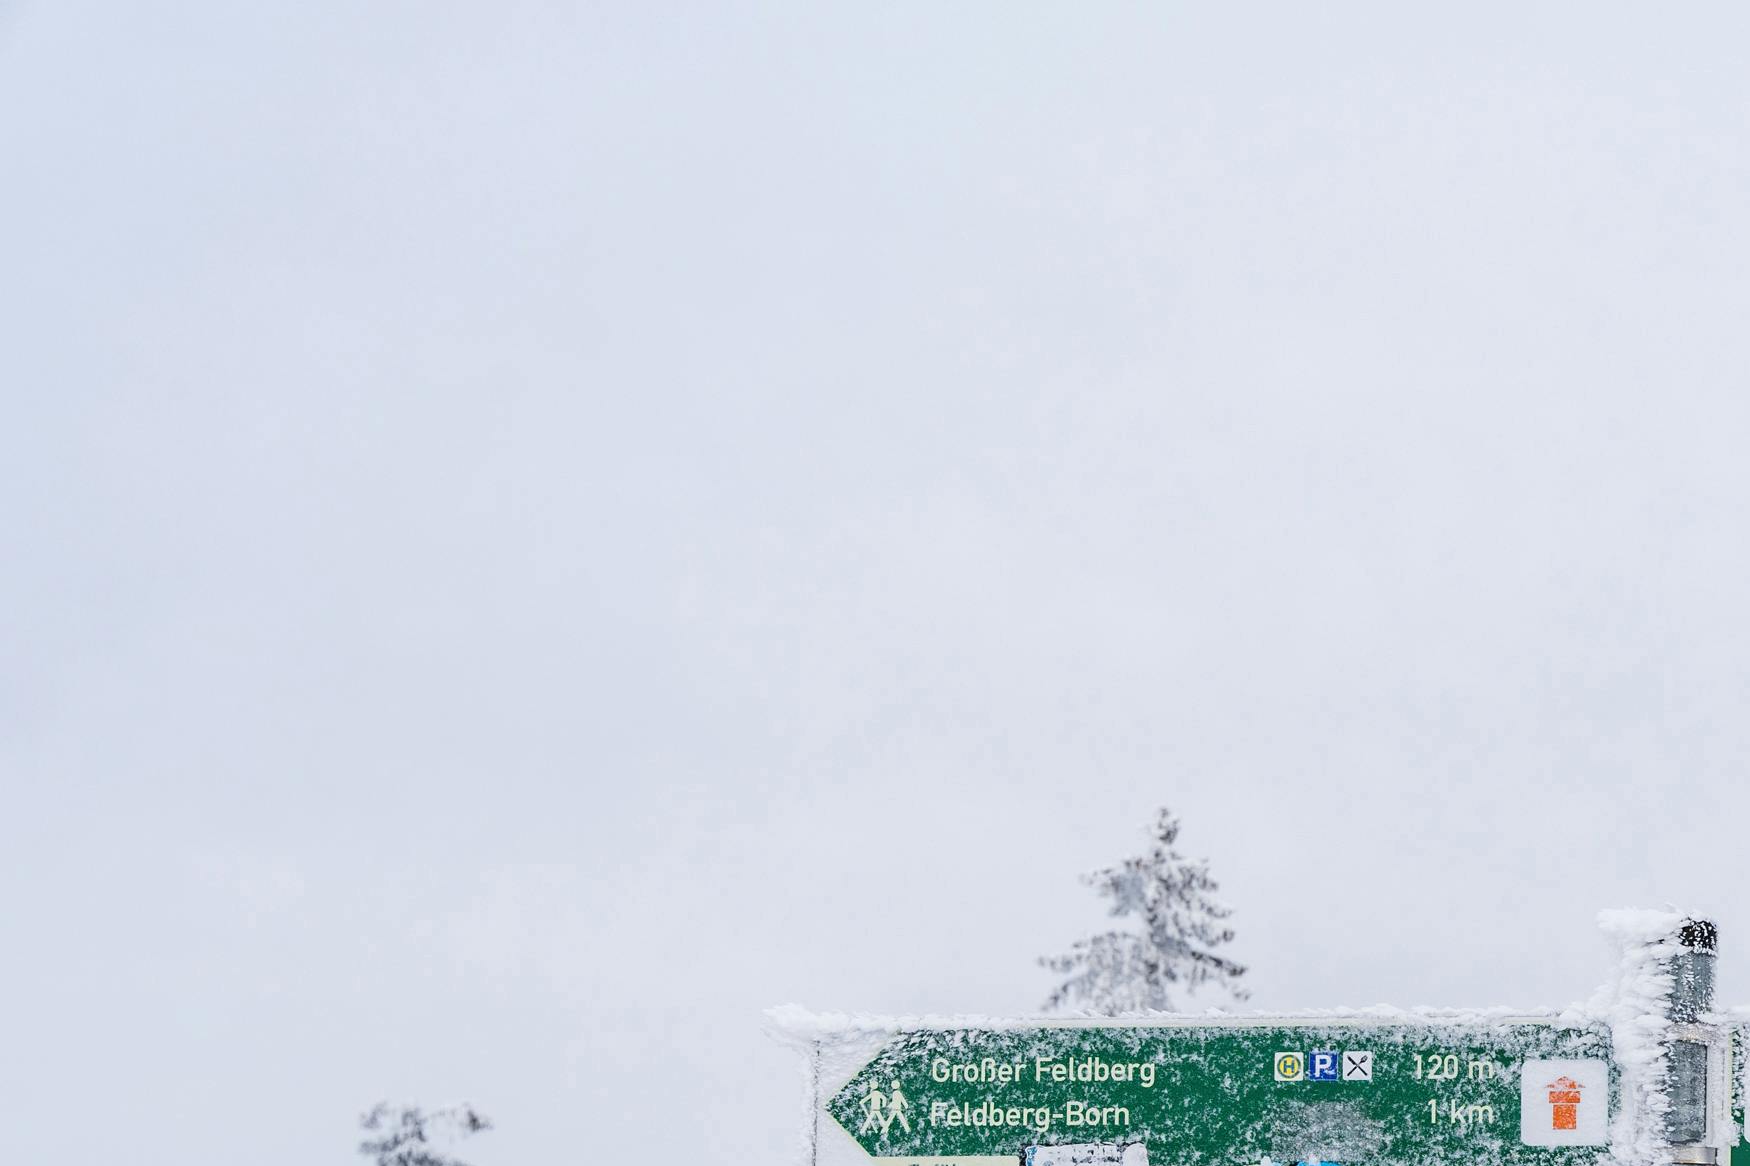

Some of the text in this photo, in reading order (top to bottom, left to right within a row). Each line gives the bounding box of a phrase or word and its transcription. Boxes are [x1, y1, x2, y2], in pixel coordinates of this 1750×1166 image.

[931, 1057, 1156, 1088] Großer Feldberg
[1412, 1055, 1494, 1080] 120 m
[931, 1102, 1130, 1132] Feldberg-Born
[1427, 1099, 1494, 1124] 1 km
